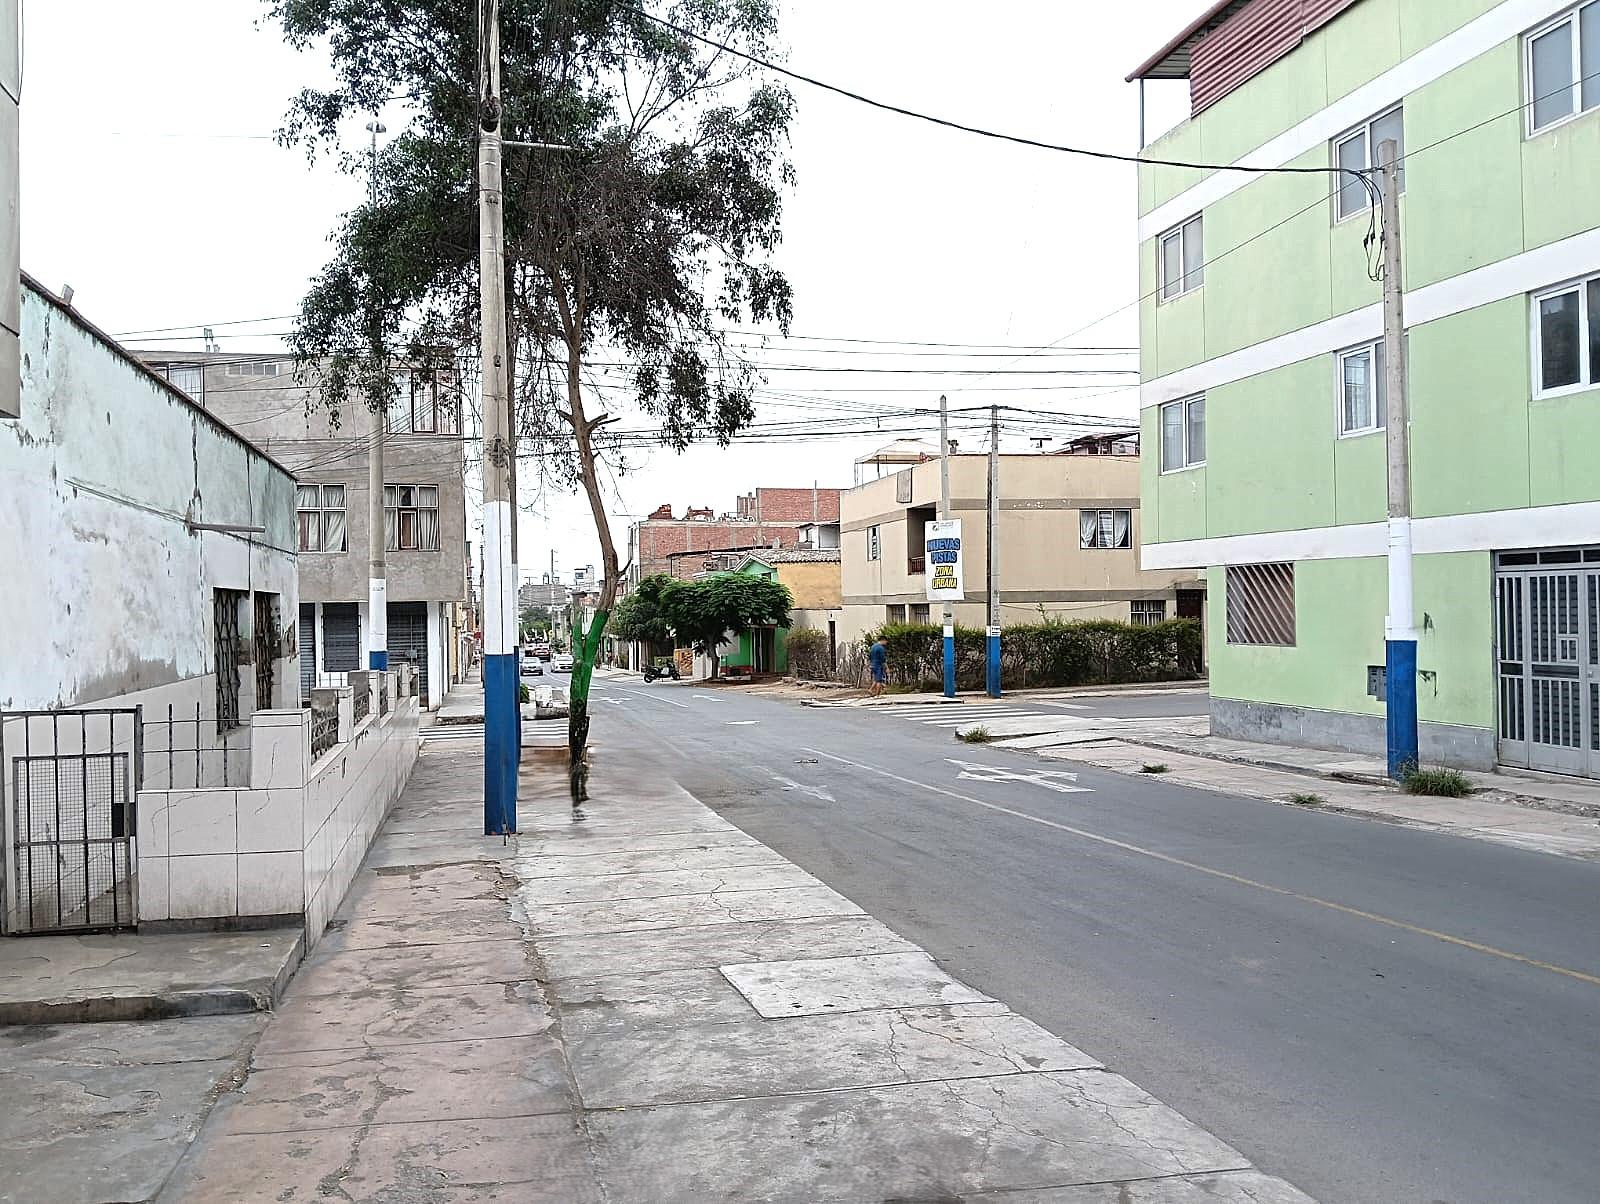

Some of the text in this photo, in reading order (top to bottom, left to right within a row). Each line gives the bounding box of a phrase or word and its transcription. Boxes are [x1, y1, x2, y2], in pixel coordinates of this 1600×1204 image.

[927, 538, 960, 552] NUEVAS
[931, 551, 957, 564] PISTAS
[935, 566, 953, 577] ZONA
[932, 578, 957, 589] URBANA
